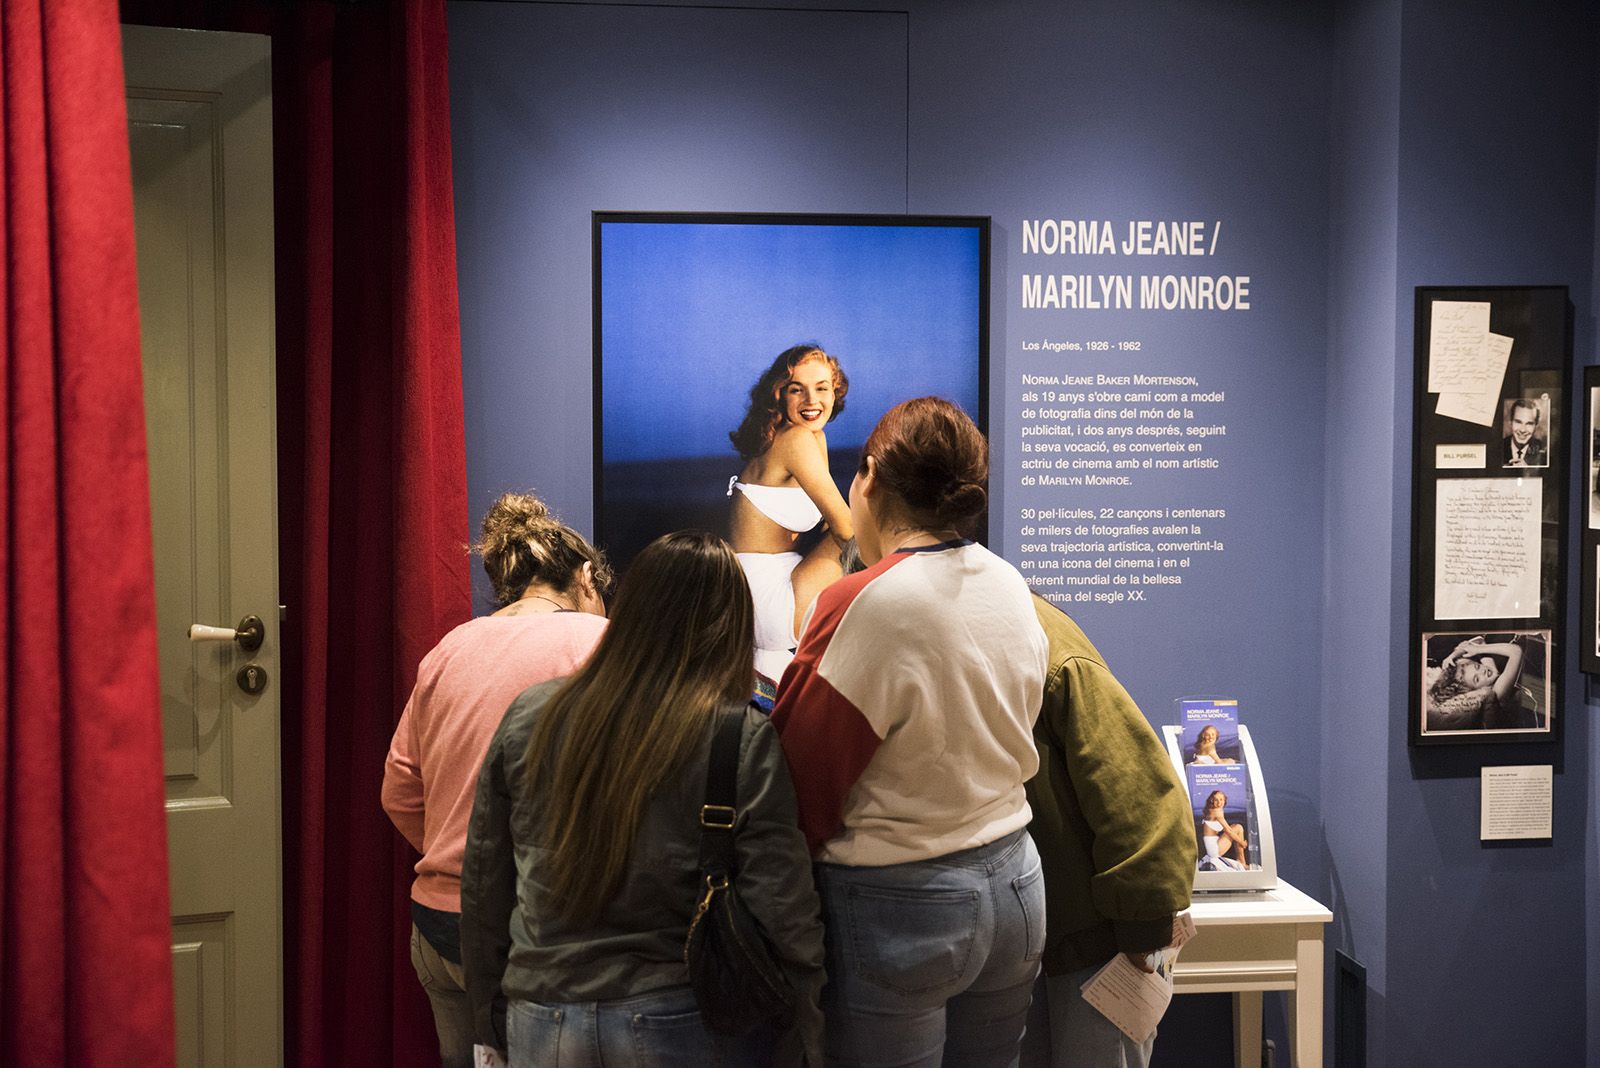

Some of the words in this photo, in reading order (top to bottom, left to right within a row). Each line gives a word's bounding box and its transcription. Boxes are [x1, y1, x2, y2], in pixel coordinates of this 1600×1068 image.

[1023, 219, 1116, 255] NORMA
[1122, 221, 1204, 255] JEANE
[1209, 221, 1221, 255] /
[1022, 275, 1132, 309] MARILYN
[1140, 275, 1250, 310] MONROE
[1023, 341, 1040, 350] Los
[1042, 339, 1082, 352] Ángeles,
[1086, 341, 1109, 350] 1926
[1118, 342, 1141, 350] 1962
[1022, 391, 1038, 402] als
[1042, 392, 1055, 402] 19
[1059, 393, 1085, 404] anys
[1088, 391, 1121, 402] s'obre
[1124, 391, 1151, 402] camí
[1154, 393, 1178, 402] com
[1181, 394, 1188, 402] a
[1191, 391, 1224, 402] model
[1022, 408, 1036, 418] de
[1039, 408, 1091, 421] fotografia
[1094, 408, 1117, 419] dins
[1120, 408, 1136, 418] del
[1140, 408, 1164, 418] món
[1167, 408, 1181, 419] de
[1184, 408, 1194, 418] la
[1022, 425, 1074, 437] publicitat,
[1084, 425, 1104, 435] dos
[1107, 427, 1133, 438] anys
[1136, 424, 1183, 437] després,
[1186, 425, 1226, 438] seguint
[1022, 442, 1032, 452] la
[1035, 444, 1061, 452] seva
[1064, 441, 1109, 453] vocació,
[1113, 444, 1126, 452] es
[1129, 441, 1185, 452] converteix
[1188, 443, 1202, 452] en
[1022, 458, 1052, 469] actriu
[1055, 458, 1069, 469] de
[1072, 458, 1112, 469] cinema
[1116, 458, 1140, 468] amb
[1142, 458, 1152, 468] el
[1156, 460, 1179, 468] nom
[1183, 458, 1219, 468] artístic
[1021, 475, 1035, 486] de
[1021, 509, 1035, 519] 30
[1100, 508, 1114, 518] 22
[1117, 510, 1163, 521] cançons
[1172, 508, 1225, 518] centenars
[1021, 525, 1035, 535] de
[1039, 525, 1071, 535] milers
[1075, 525, 1088, 535] de
[1092, 524, 1149, 537] fotografies
[1152, 524, 1188, 535] avalen
[1191, 524, 1201, 534] la
[1021, 544, 1047, 552] seva
[1051, 541, 1105, 554] trajectoria
[1108, 541, 1154, 552] artística,
[1157, 540, 1224, 551] convertint-la
[1021, 561, 1035, 569] en
[1038, 560, 1059, 568] una
[1062, 558, 1092, 568] icona
[1095, 558, 1111, 568] del
[1115, 558, 1154, 568] cinema
[1163, 560, 1177, 568] en
[1180, 557, 1190, 567] el
[1067, 574, 1110, 585] mundial
[1113, 574, 1127, 584] de
[1130, 574, 1140, 584] la
[1143, 574, 1182, 584] bellesa
[1074, 591, 1091, 601] del
[1095, 591, 1124, 604] segle
[1127, 590, 1146, 601] XX.
